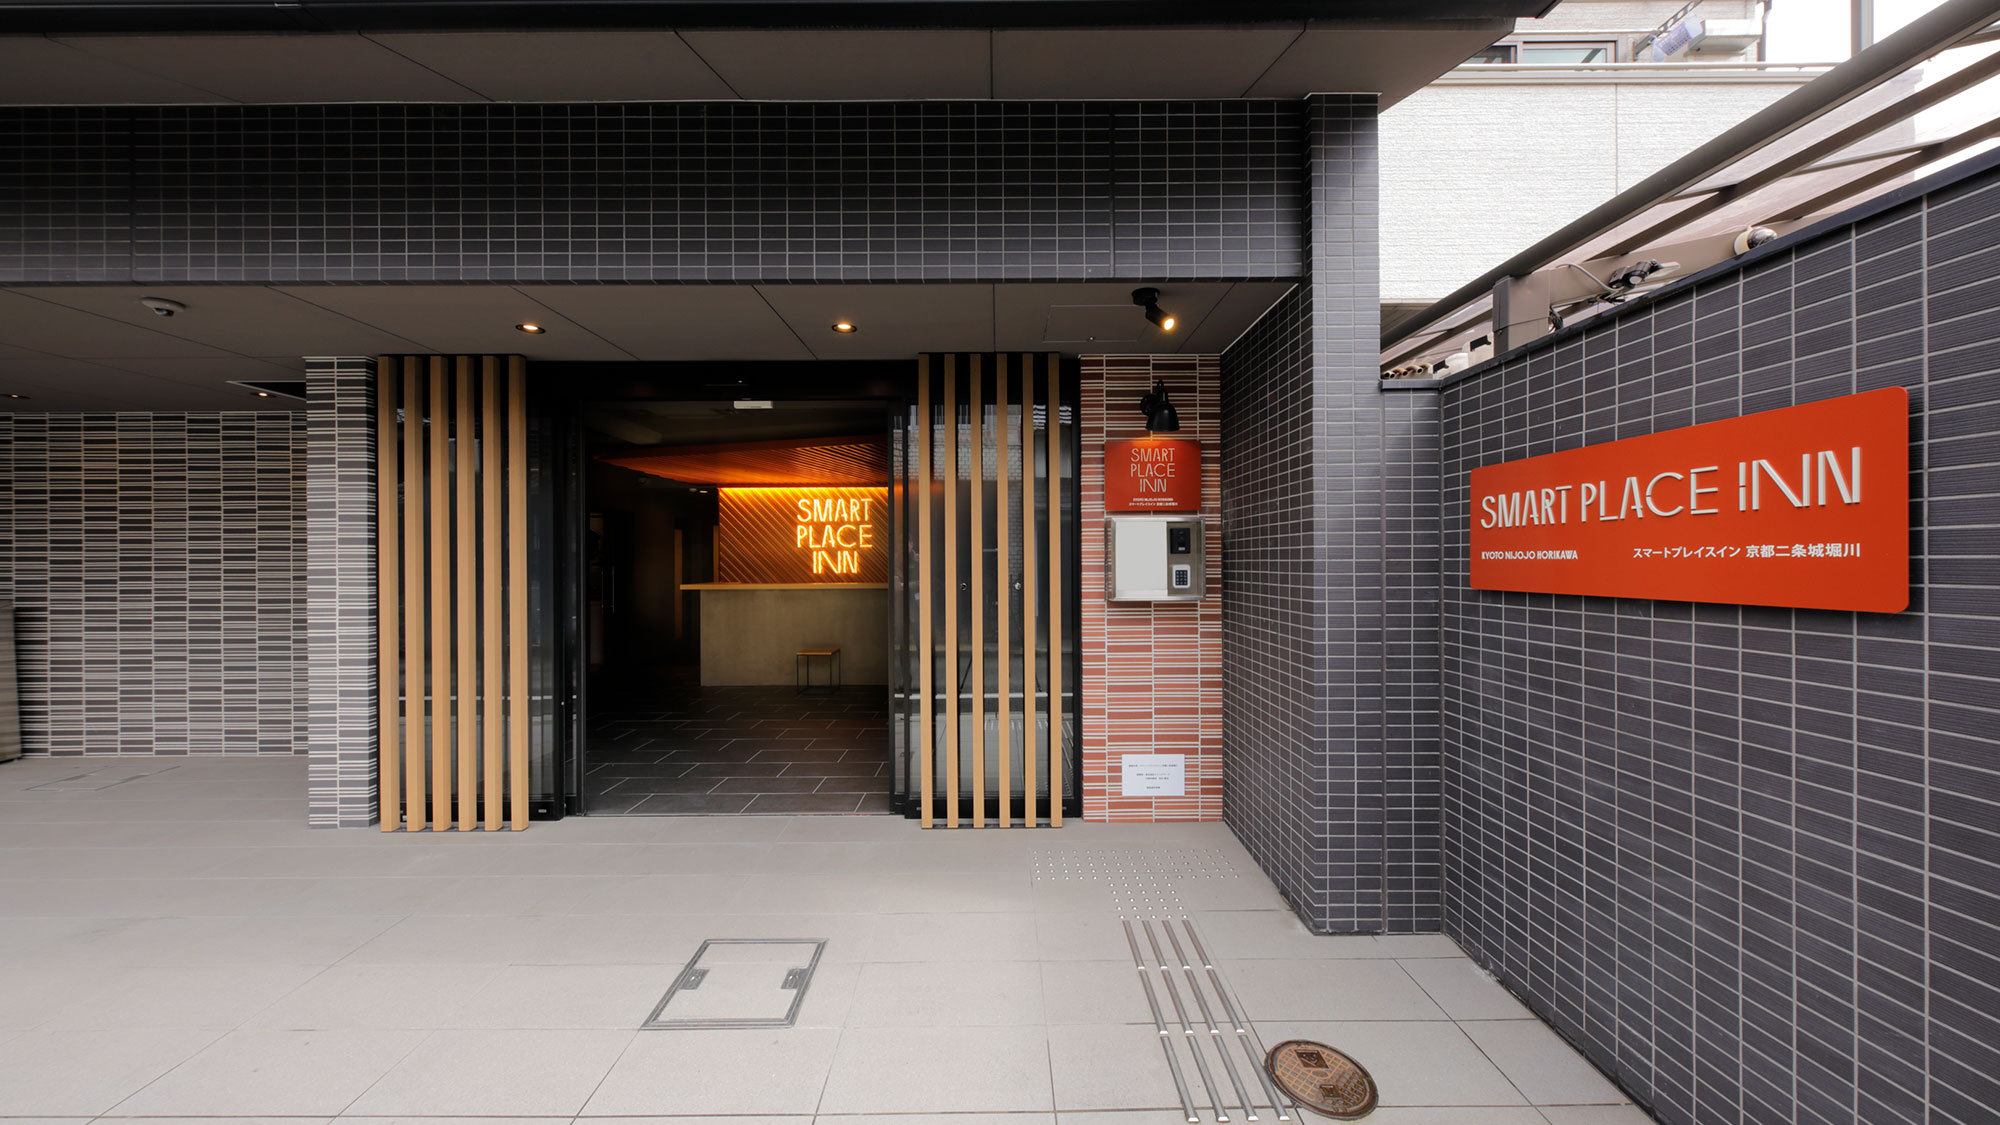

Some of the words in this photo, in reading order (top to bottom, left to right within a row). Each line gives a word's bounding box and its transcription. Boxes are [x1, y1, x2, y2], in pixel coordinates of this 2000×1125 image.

[1130, 447, 1176, 462] SMART
[1130, 463, 1176, 478] PLACE
[1139, 478, 1167, 493] INN
[1480, 485, 1573, 529] SMART
[1580, 465, 1719, 523] PLACE
[1738, 446, 1861, 512] INN
[796, 498, 873, 522] SMART
[796, 524, 873, 548] PLACE
[1481, 551, 1504, 560] KYOTO
[1505, 550, 1536, 560] NIJOJO
[1536, 550, 1579, 560] HORIKAWA
[1632, 545, 1741, 559] スマートプレイスイン
[1745, 543, 1861, 559] 京都二条城堀川
[812, 550, 858, 574] INN
